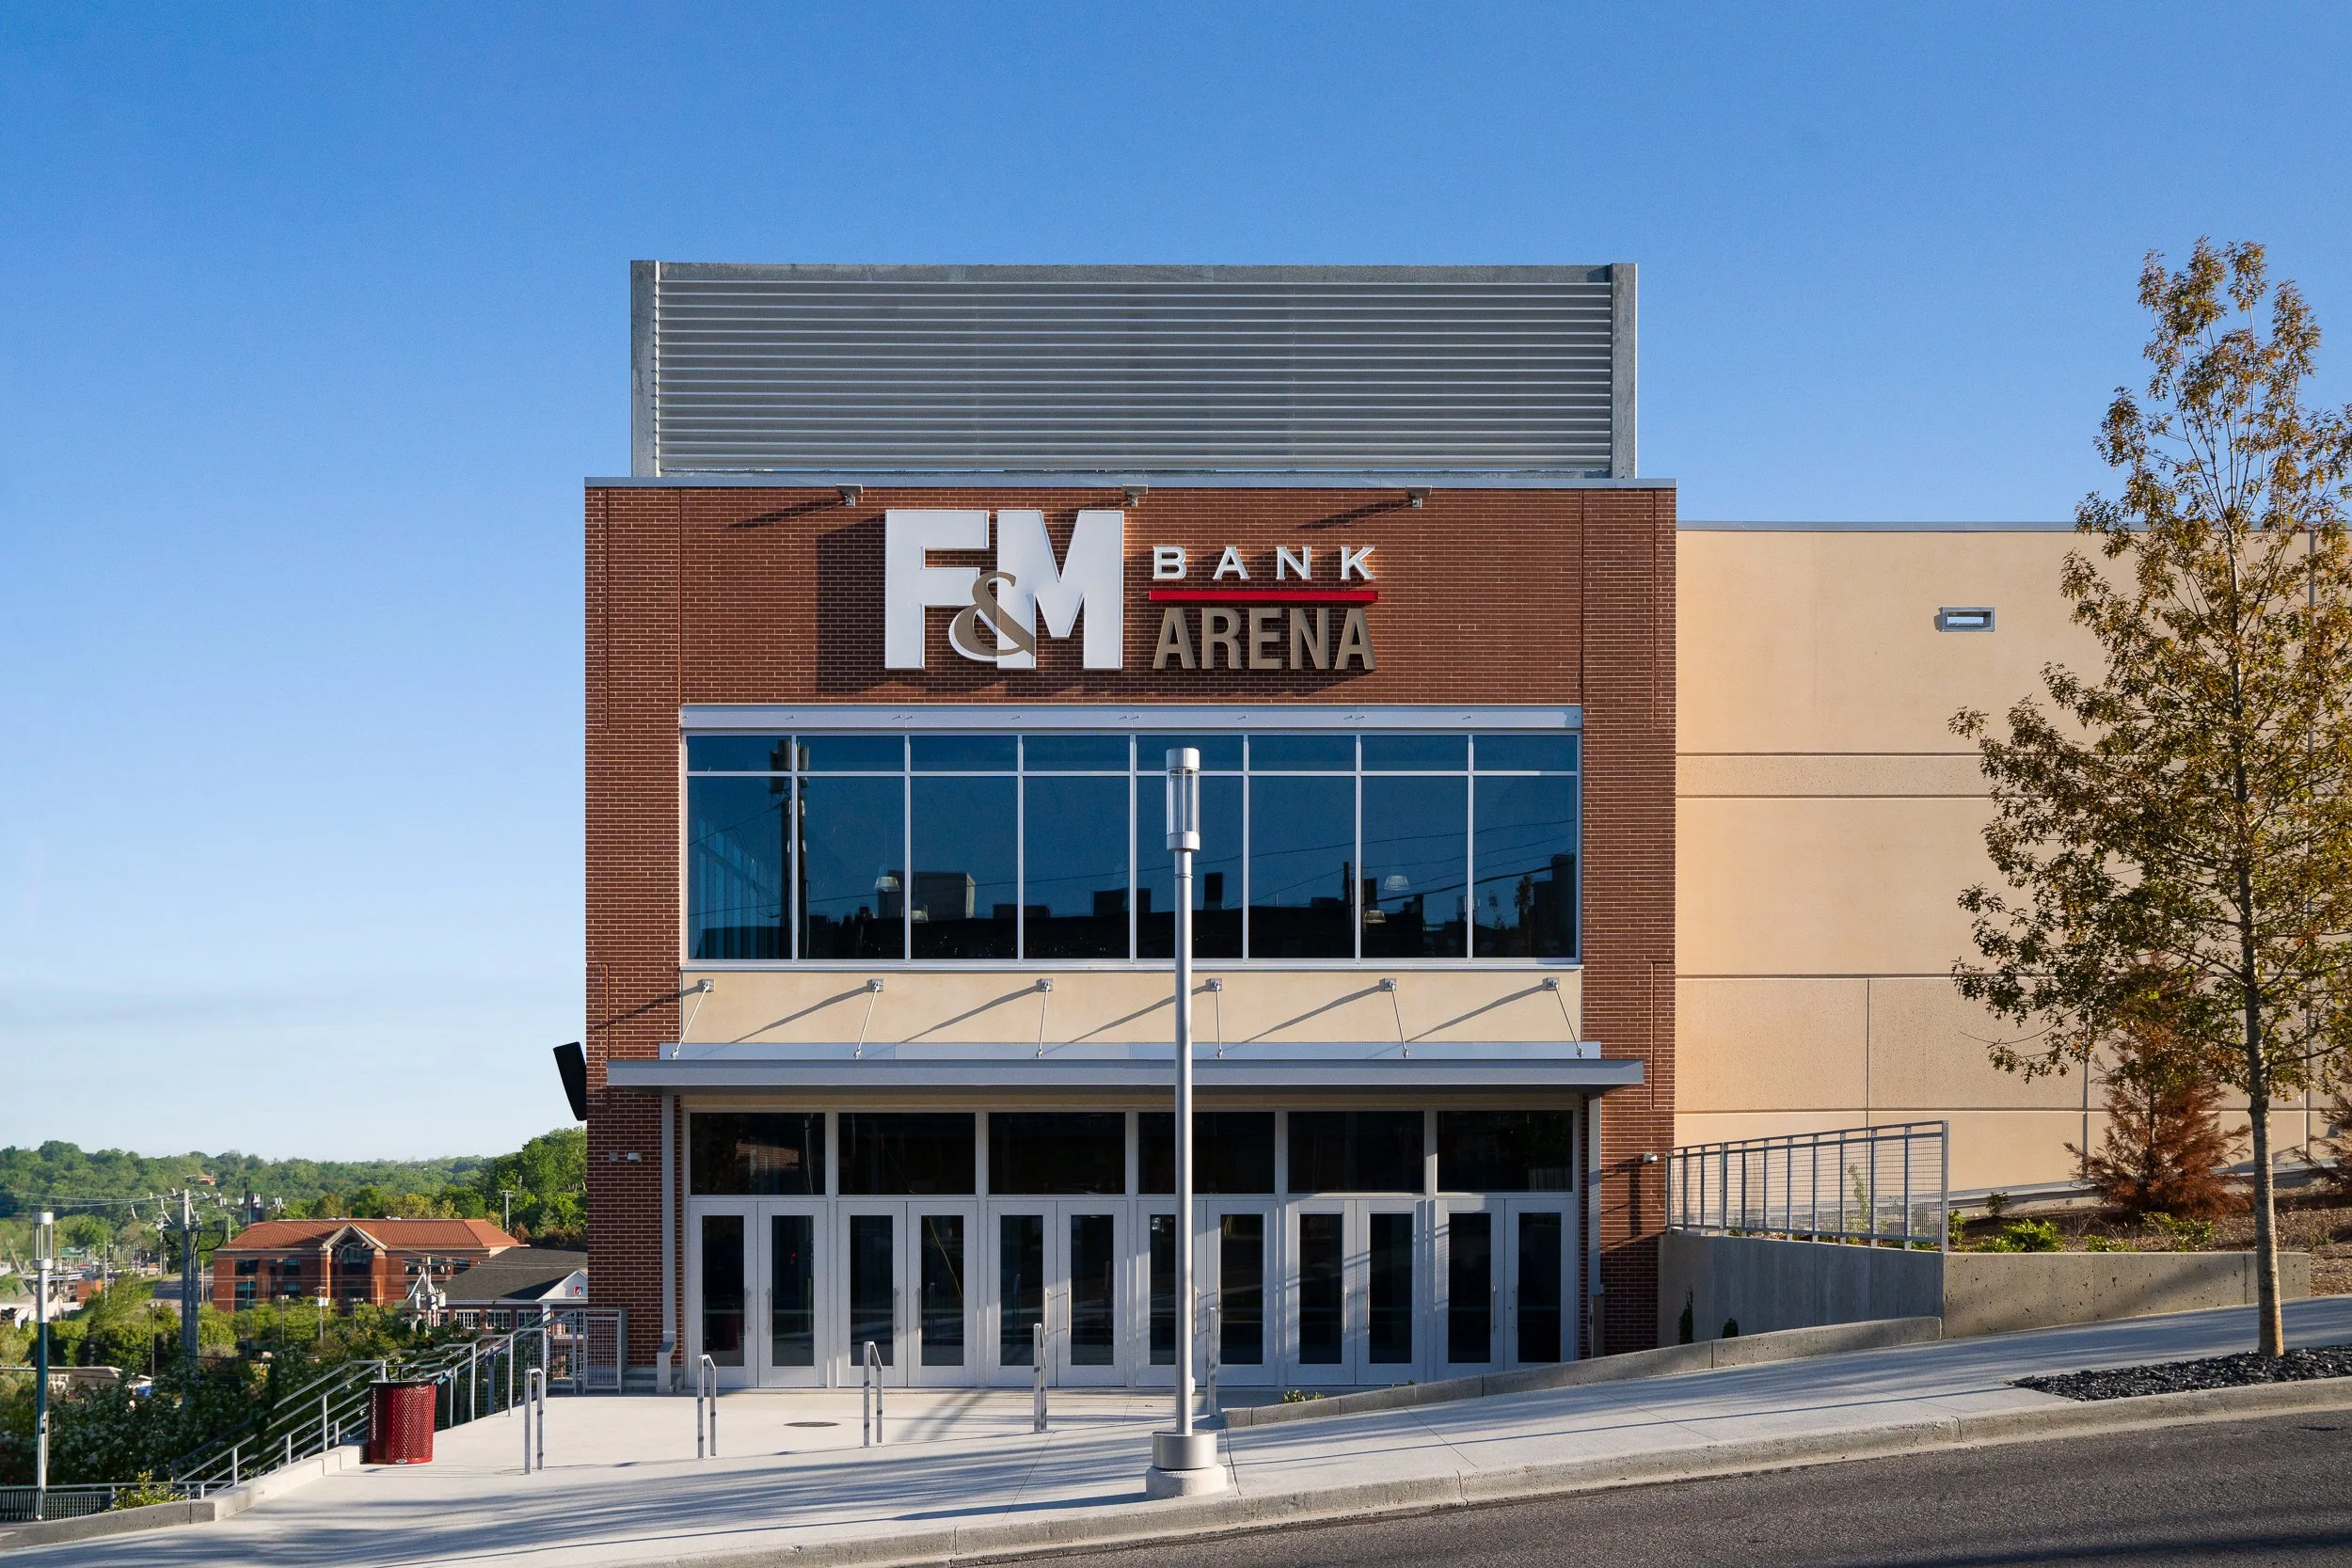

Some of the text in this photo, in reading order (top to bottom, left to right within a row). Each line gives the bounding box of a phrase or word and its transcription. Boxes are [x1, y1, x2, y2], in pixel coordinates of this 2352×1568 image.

[884, 509, 1124, 670] F&M
[1152, 546, 1375, 580] BANK
[1152, 607, 1377, 670] ARENA
